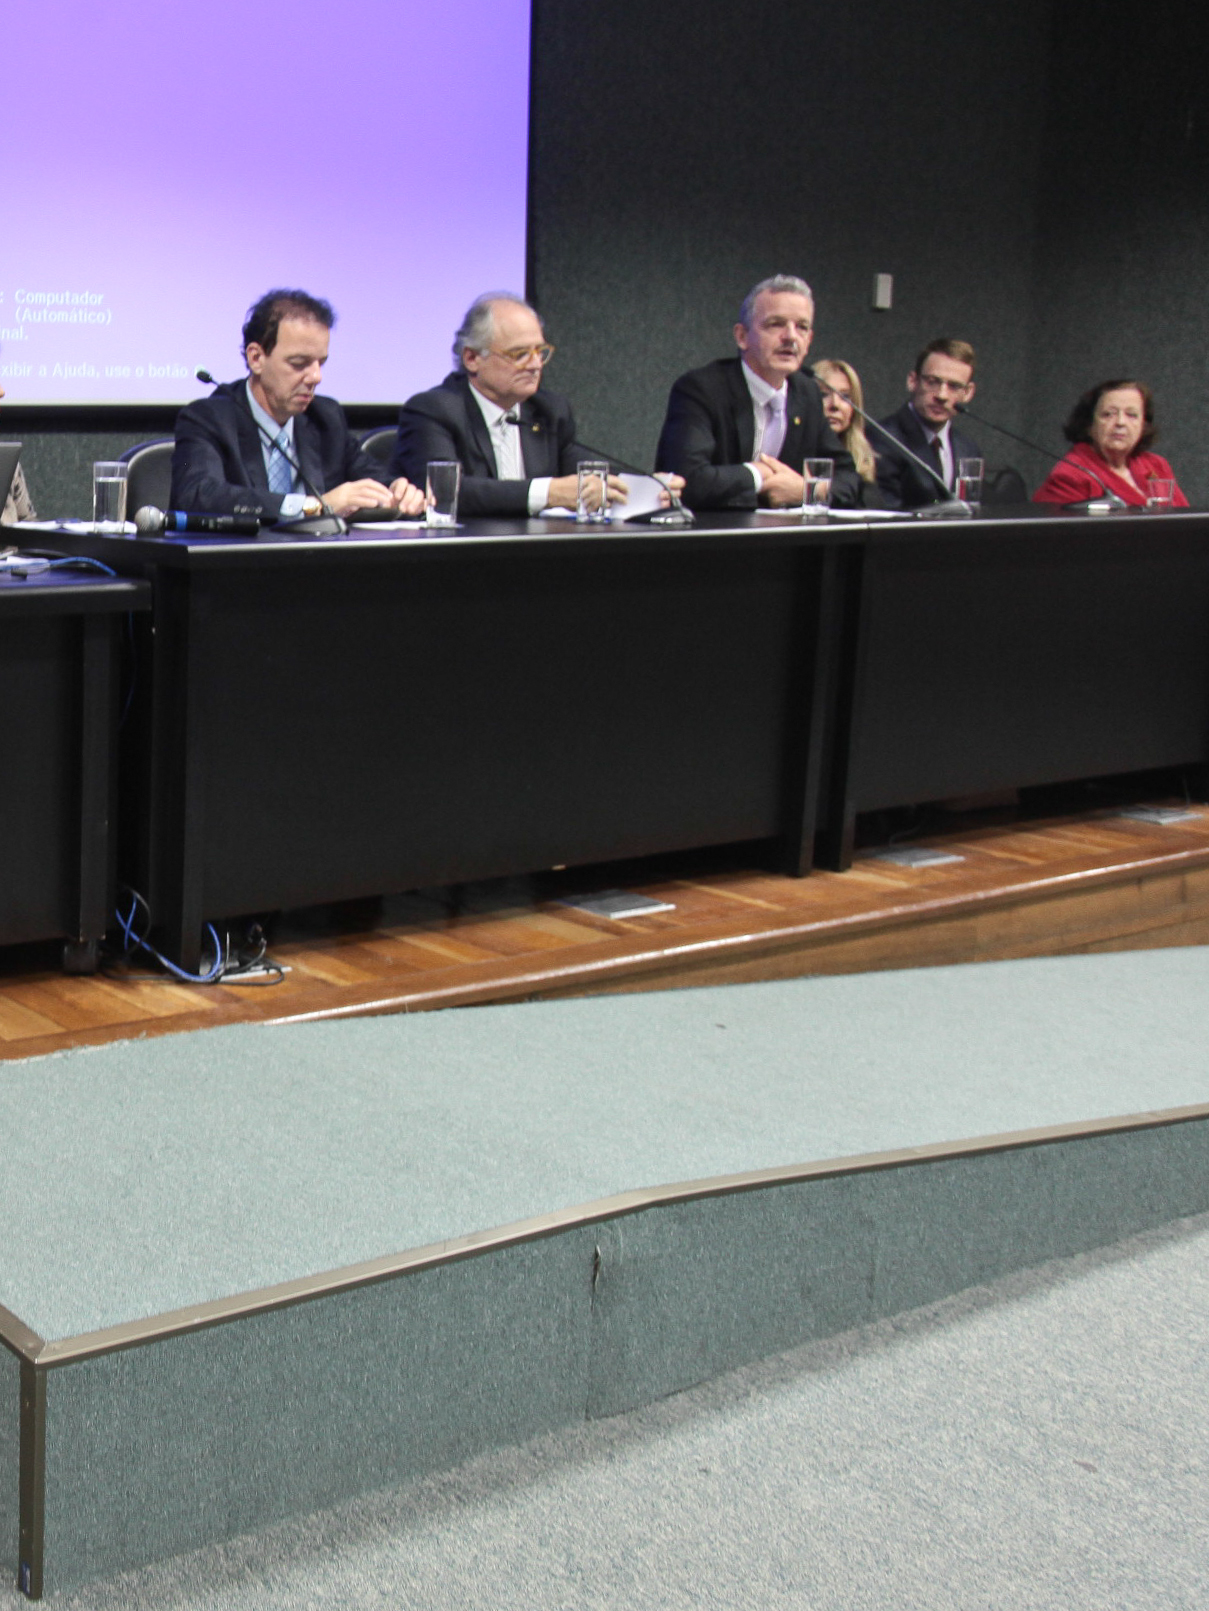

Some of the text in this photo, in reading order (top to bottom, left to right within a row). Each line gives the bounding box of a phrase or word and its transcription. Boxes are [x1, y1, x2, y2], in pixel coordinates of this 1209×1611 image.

[14, 287, 105, 307] Computador
[14, 304, 112, 326] (Automático)
[104, 364, 131, 377] use
[135, 365, 145, 377] o
[148, 361, 188, 378] botão
